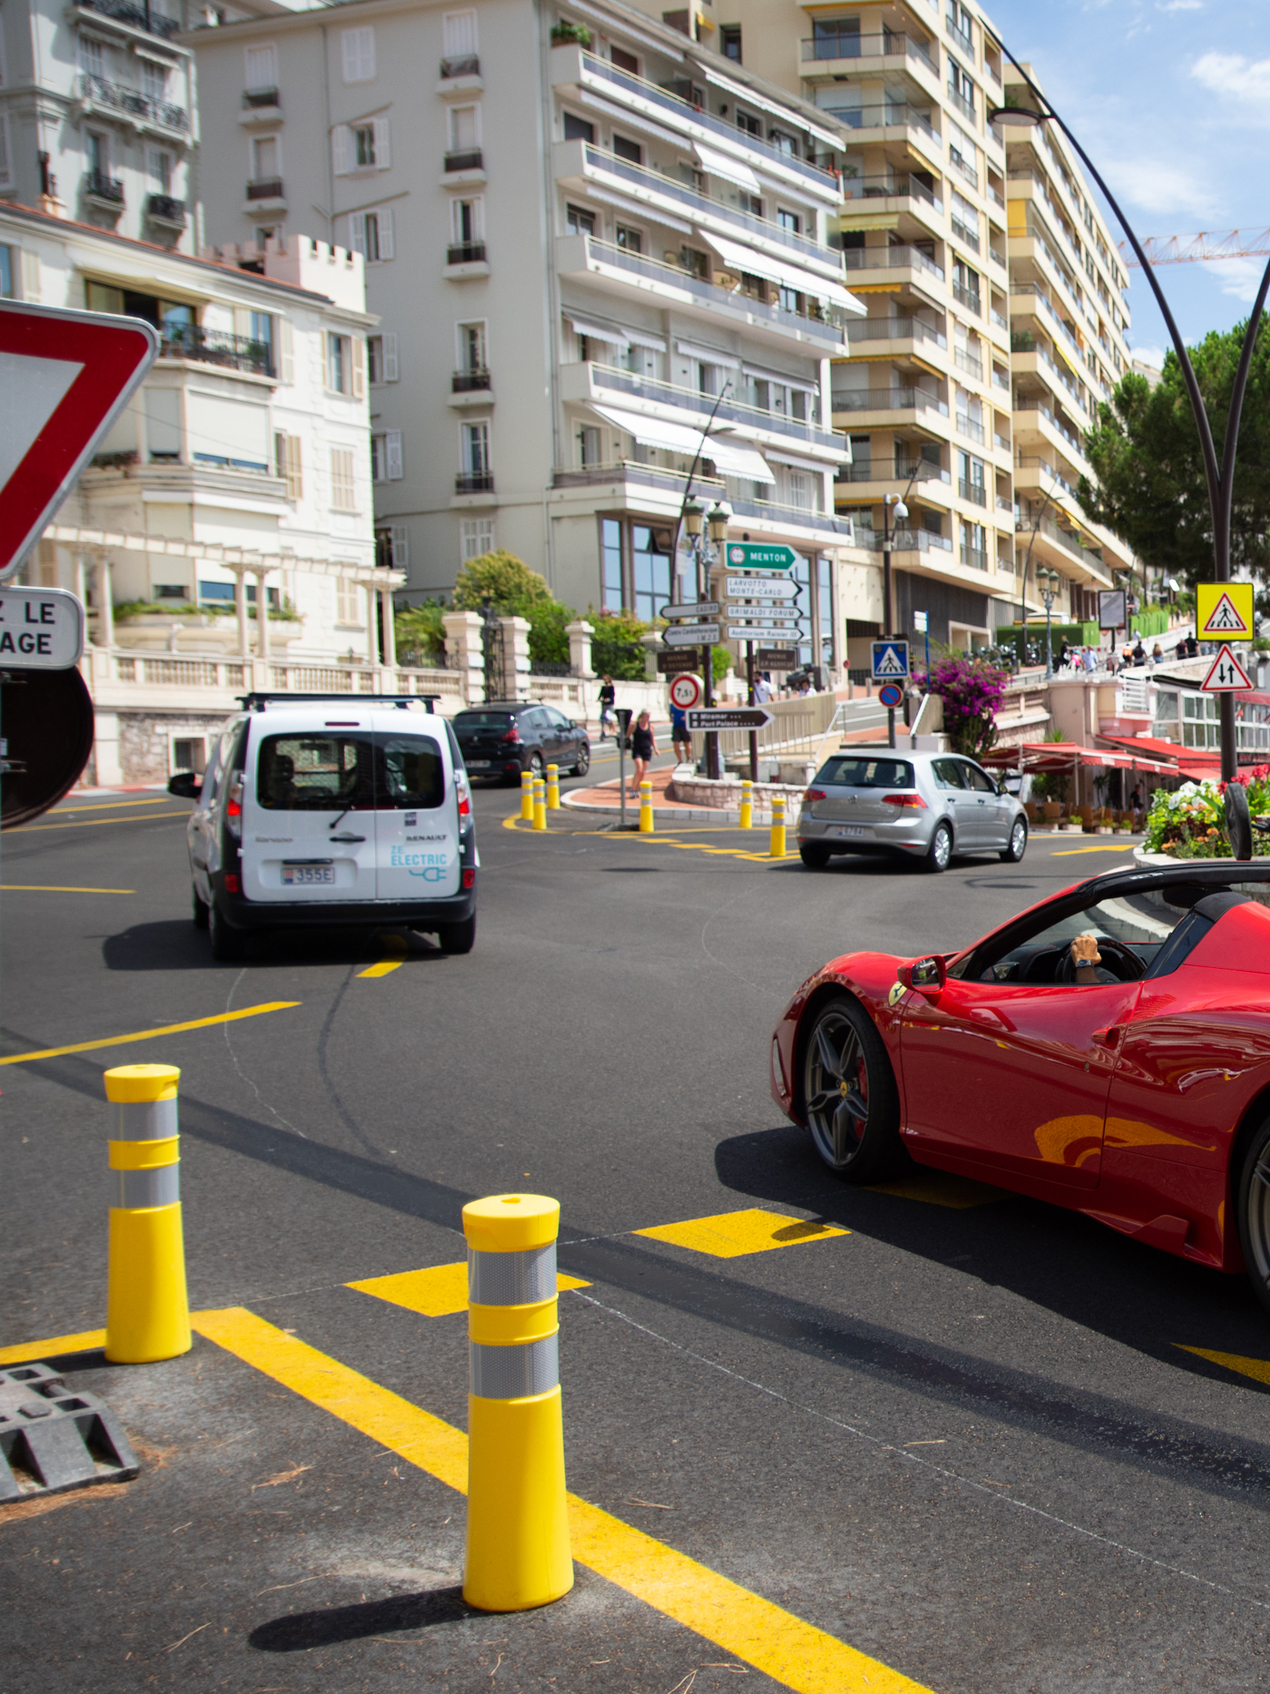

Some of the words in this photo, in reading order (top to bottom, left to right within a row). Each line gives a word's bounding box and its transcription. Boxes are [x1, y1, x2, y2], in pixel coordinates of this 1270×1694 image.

[750, 552, 787, 563] MENTON
[729, 579, 767, 587] LARVOTTO
[729, 587, 782, 596] MONTE-CARLO
[25, 601, 56, 625] LE
[716, 719, 738, 727] Palace
[406, 834, 447, 842] RENAULT
[391, 853, 447, 866] ELECTRIC
[296, 869, 331, 881] 355E
